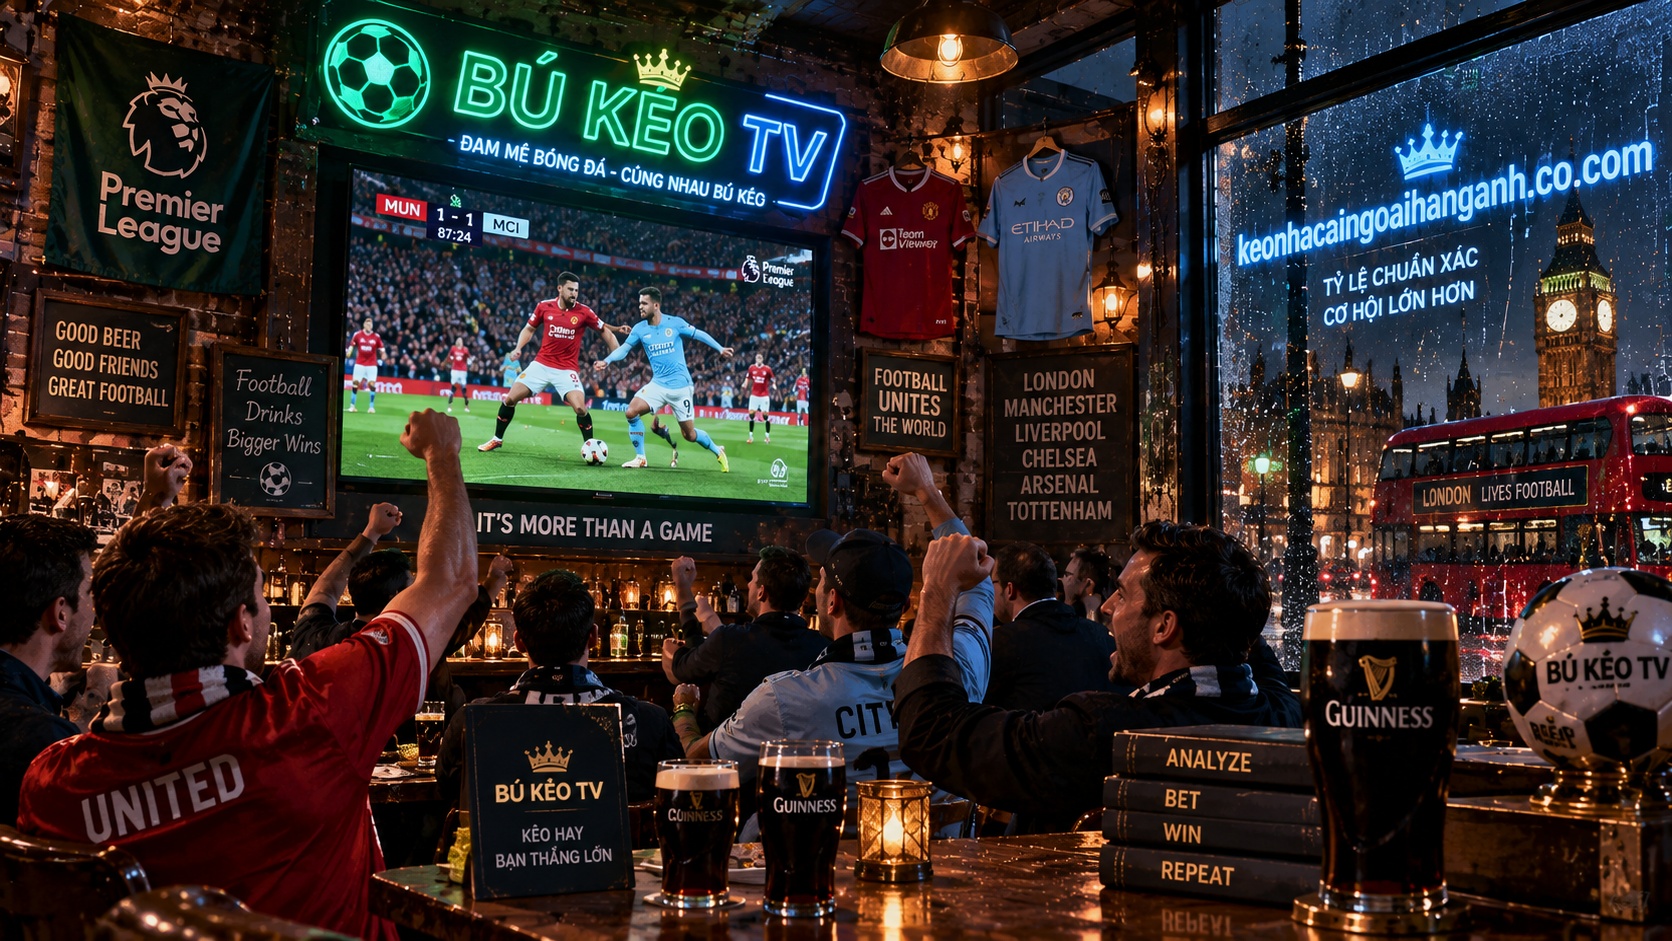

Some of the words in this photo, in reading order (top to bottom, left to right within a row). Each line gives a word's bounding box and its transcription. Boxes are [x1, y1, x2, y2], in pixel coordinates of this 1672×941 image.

[454, 50, 566, 130] BÚ
[742, 114, 827, 182] TV
[460, 135, 500, 158] ĐAM
[533, 148, 580, 173] BÓNG
[584, 157, 606, 178] ĐÁ
[668, 175, 710, 197] NHAU
[100, 170, 224, 224] Premier
[1237, 140, 1653, 268] keonhacaingoaihanganh.co.com
[98, 203, 222, 255] League
[384, 198, 421, 217] MUN
[436, 207, 445, 223] 1
[465, 212, 474, 227] 1
[493, 218, 520, 234] MCI
[1011, 217, 1075, 235] ETIHAD
[438, 227, 472, 243] 87:24
[1023, 232, 1062, 244] AIRWAYS
[1349, 266, 1368, 294] LỆ
[1440, 244, 1479, 274] XÁC
[1323, 302, 1348, 327] CƠ
[1352, 294, 1383, 323] HỘI
[1388, 287, 1426, 315] LỚN
[1431, 280, 1475, 307] HƠN
[55, 320, 98, 345] GOOD
[103, 326, 142, 351] BEER
[53, 348, 95, 372] GOOD
[99, 353, 159, 380] FRIENDS
[48, 376, 95, 400] GREAT
[100, 381, 169, 408] FOOTBALL
[235, 368, 313, 398] Football
[875, 367, 948, 393] FOOTBALL
[1023, 368, 1095, 392] LONDON
[245, 400, 303, 425] Drinks
[879, 389, 941, 417] UNITES
[1004, 393, 1117, 418] MANCHESTER
[873, 415, 898, 434] THE
[901, 418, 947, 438] WORLD
[1015, 420, 1106, 443] LIVERPOOL
[227, 428, 280, 456] Bigger
[284, 433, 322, 454] Wins
[1022, 447, 1097, 469] CHELSEA
[1020, 474, 1099, 495] ARSENAL
[1423, 484, 1471, 508] LONDON
[1515, 479, 1575, 501] FOOTBALL
[1007, 500, 1112, 521] TOTTENHAM
[477, 511, 513, 535] IT'S
[519, 514, 577, 537] MORE
[583, 517, 635, 539] THAN
[640, 519, 654, 540] A
[659, 521, 713, 543] GAME
[1546, 652, 1578, 685] BÚ
[1637, 656, 1670, 680] TV
[1325, 700, 1434, 729] GUINNESS
[1166, 748, 1252, 773] ANALYZE
[81, 753, 245, 845] UNITED
[495, 778, 525, 803] BÚ
[575, 781, 604, 800] TV
[1164, 788, 1201, 810] BET
[773, 797, 837, 813] GUINNESS
[555, 825, 584, 841] HAY
[1163, 822, 1202, 844] WIN
[495, 852, 526, 871] BẠN
[1161, 860, 1235, 887] REPEAT
